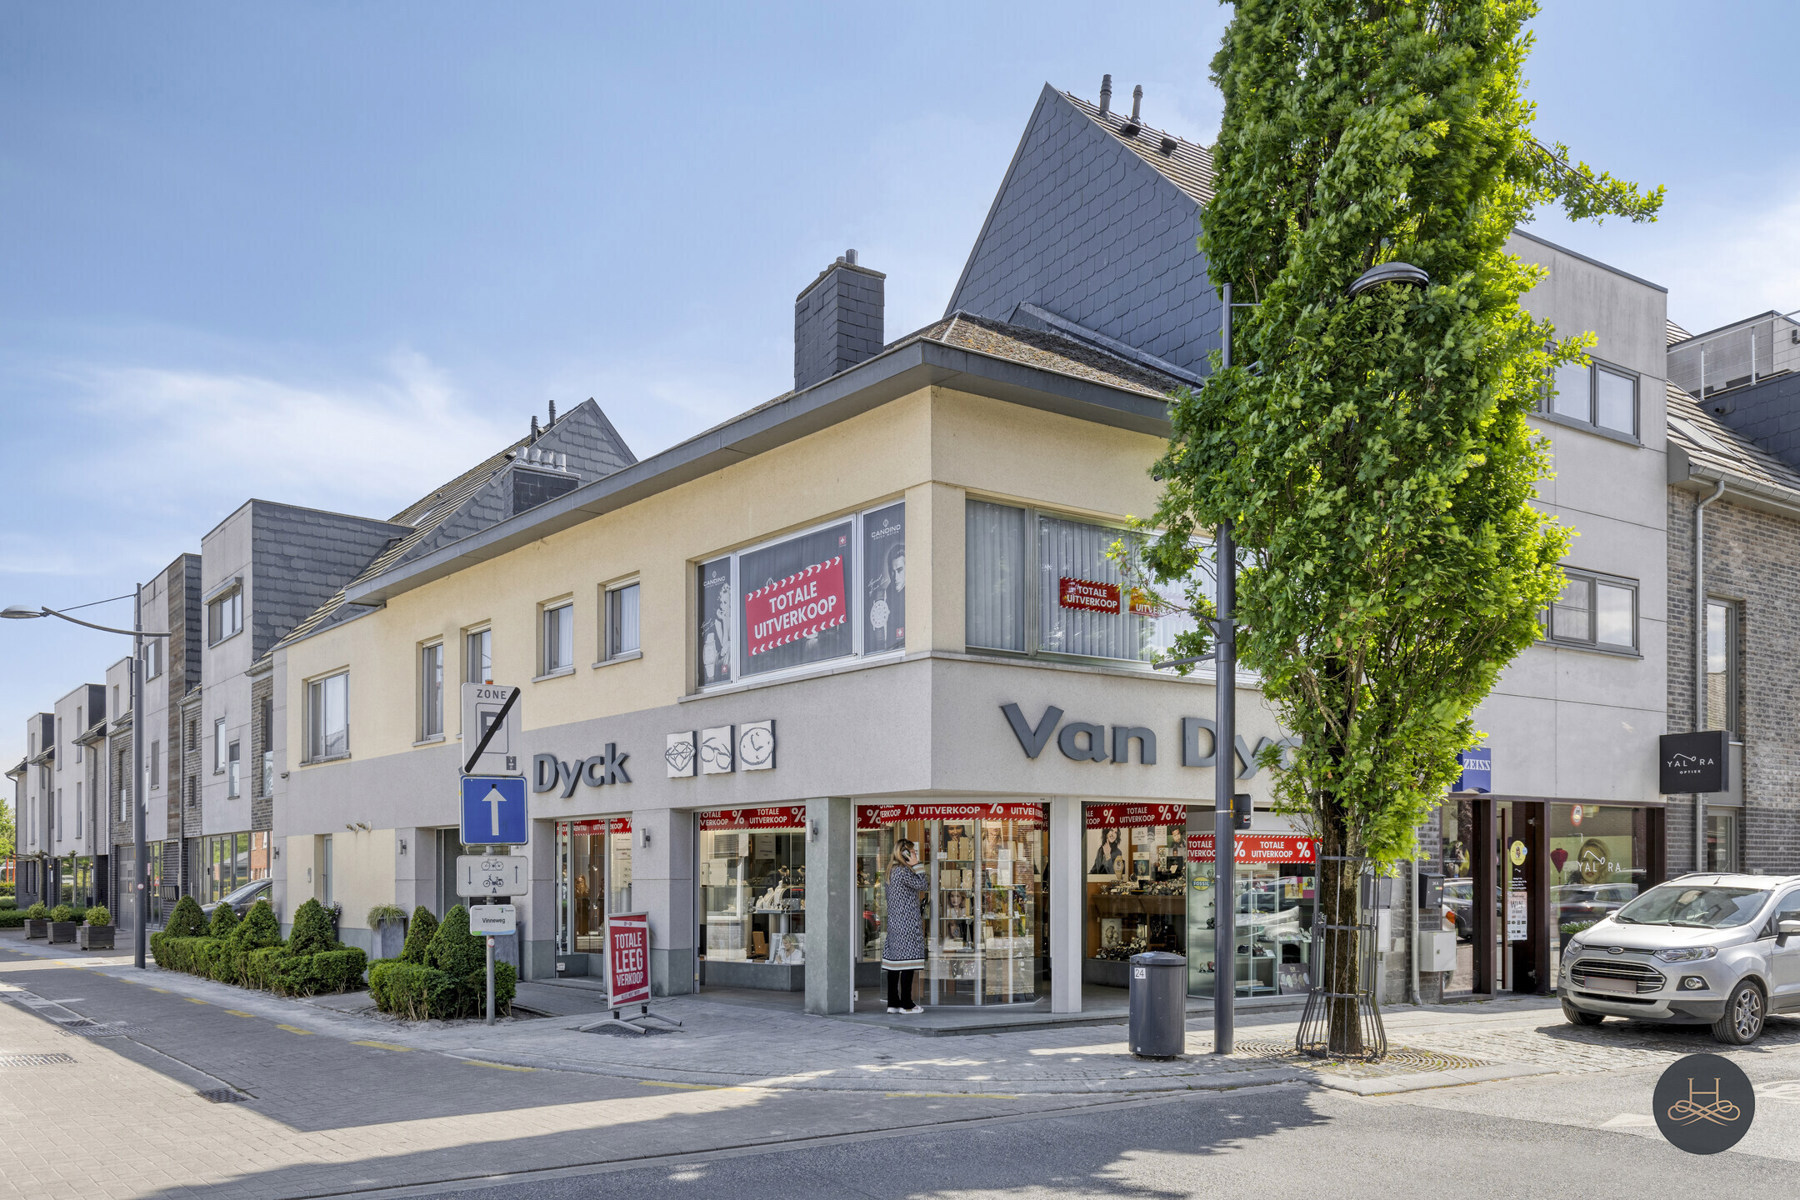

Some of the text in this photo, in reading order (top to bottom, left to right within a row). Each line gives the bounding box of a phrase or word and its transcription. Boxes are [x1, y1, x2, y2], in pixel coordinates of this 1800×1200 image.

[871, 524, 901, 538] CANDINO
[769, 581, 818, 613] TOTALE
[1078, 586, 1107, 598] TOTALE
[1067, 594, 1118, 609] UITVERKOOP
[754, 595, 837, 639] UITVERKOOP
[476, 689, 507, 700] ZONE
[999, 702, 1303, 780] Van Dyc
[533, 742, 632, 799] Dyck
[1464, 759, 1491, 771] ZEISS
[757, 807, 779, 816] TOTALE
[919, 806, 981, 815] UITVERKOOP
[1126, 806, 1148, 815] TOTALE
[749, 815, 788, 824] UITVERKOOP
[1119, 814, 1156, 824] UITVERKOOP
[1188, 840, 1213, 848] TOTALE
[1260, 841, 1285, 849] TOTALE
[1251, 850, 1294, 858] UITVERKOOP
[614, 931, 643, 950] TOTALE
[615, 948, 644, 974] LEEG
[616, 972, 644, 987] VERKOOP
[1135, 969, 1145, 978] 24
